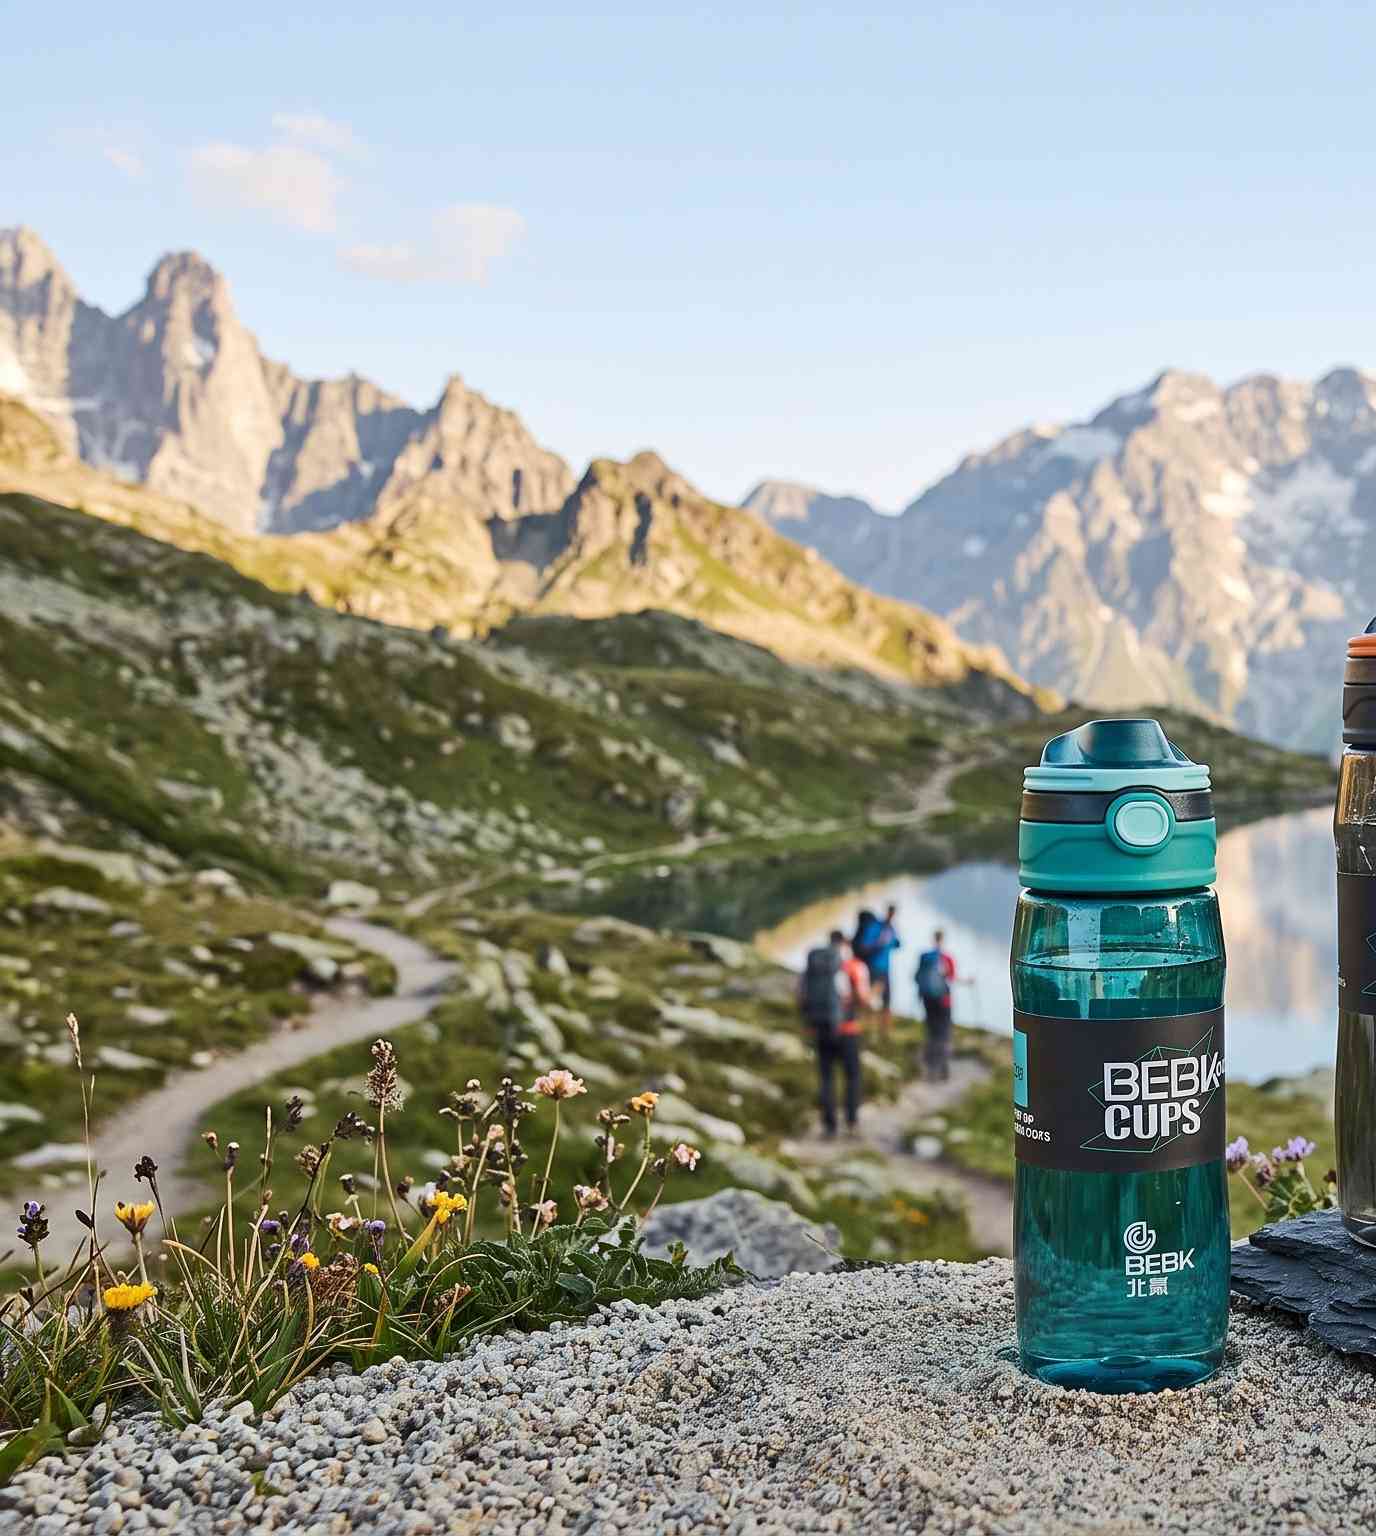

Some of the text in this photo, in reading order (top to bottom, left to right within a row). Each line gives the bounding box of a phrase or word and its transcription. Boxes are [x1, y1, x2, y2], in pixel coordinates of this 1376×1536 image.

[1103, 1050, 1220, 1101] BEBK
[1104, 1098, 1201, 1140] CUPS
[1125, 1247, 1195, 1276] BEBK
